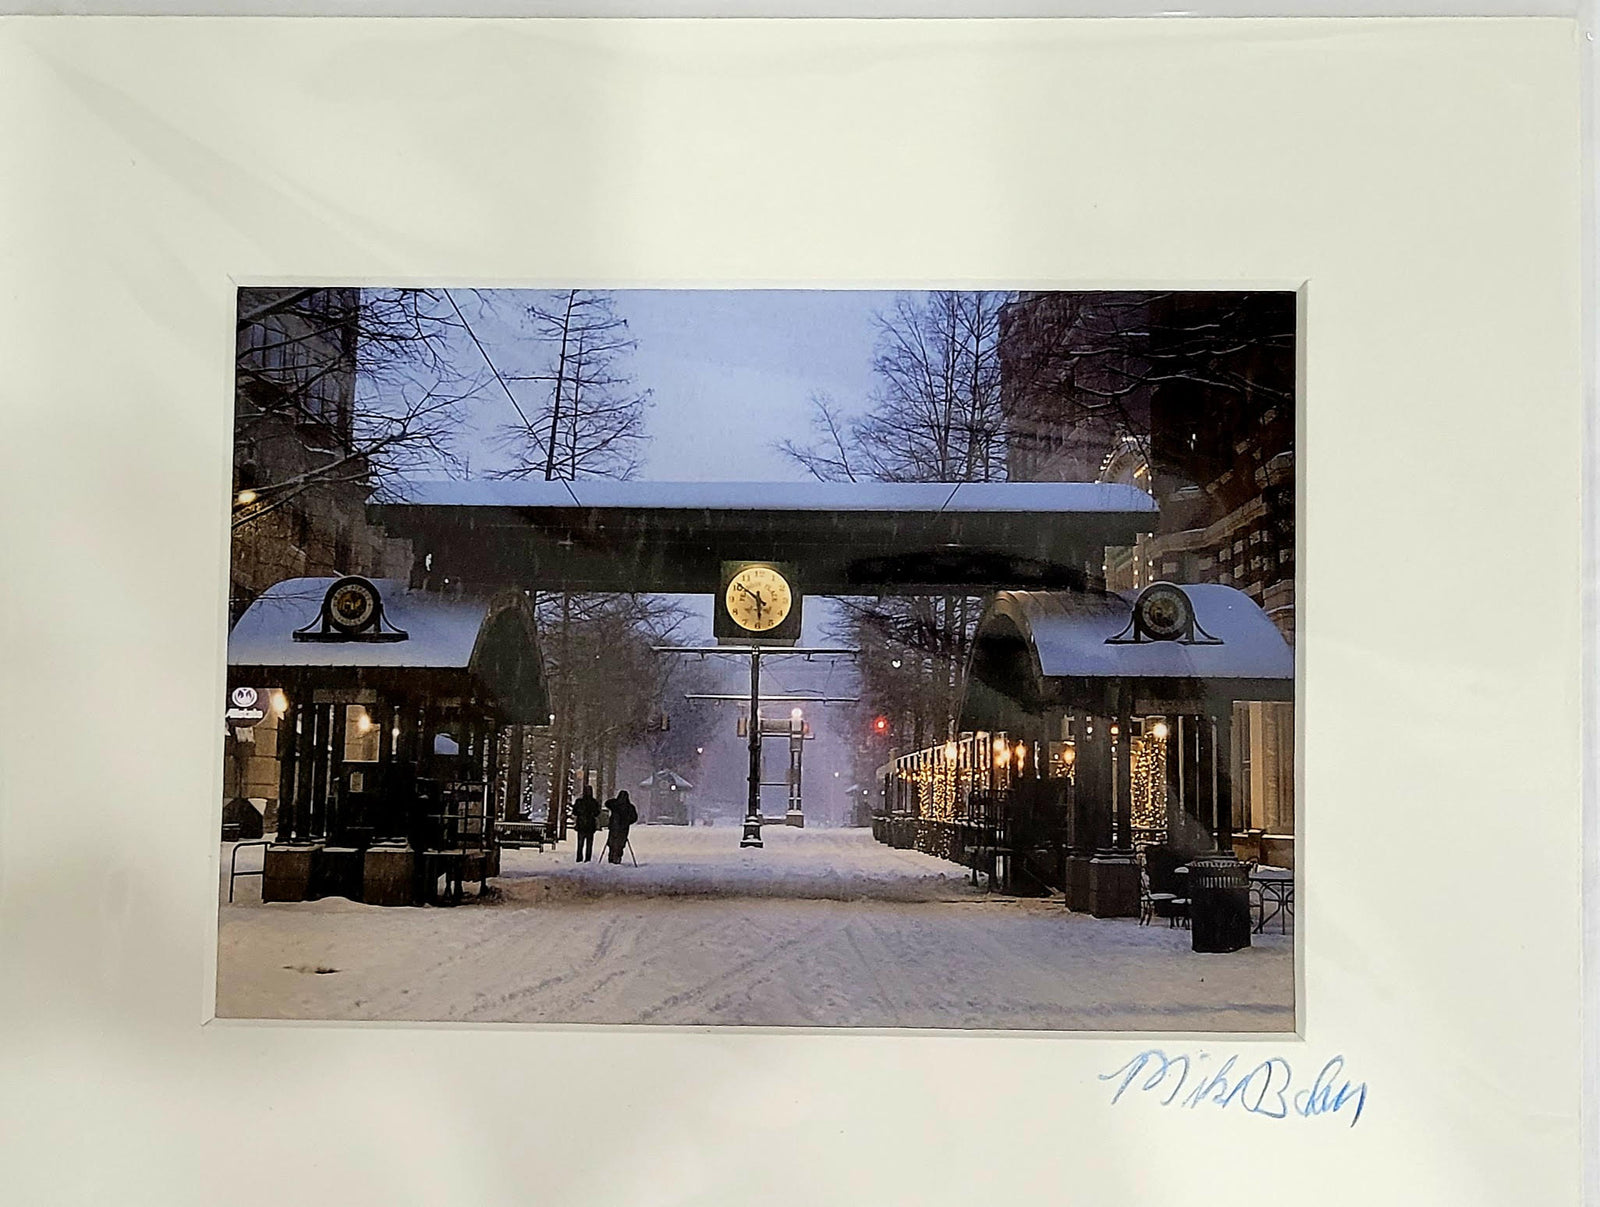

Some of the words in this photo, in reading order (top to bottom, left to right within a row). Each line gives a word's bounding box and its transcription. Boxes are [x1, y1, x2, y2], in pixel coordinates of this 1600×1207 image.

[742, 574, 751, 582] 11
[778, 584, 785, 592] 2
[728, 595, 735, 603] 9
[782, 596, 789, 604] 3
[732, 608, 739, 616] 8
[776, 609, 783, 617] 4
[741, 618, 749, 626] 7
[754, 621, 761, 629] 6
[767, 619, 774, 627] 5
